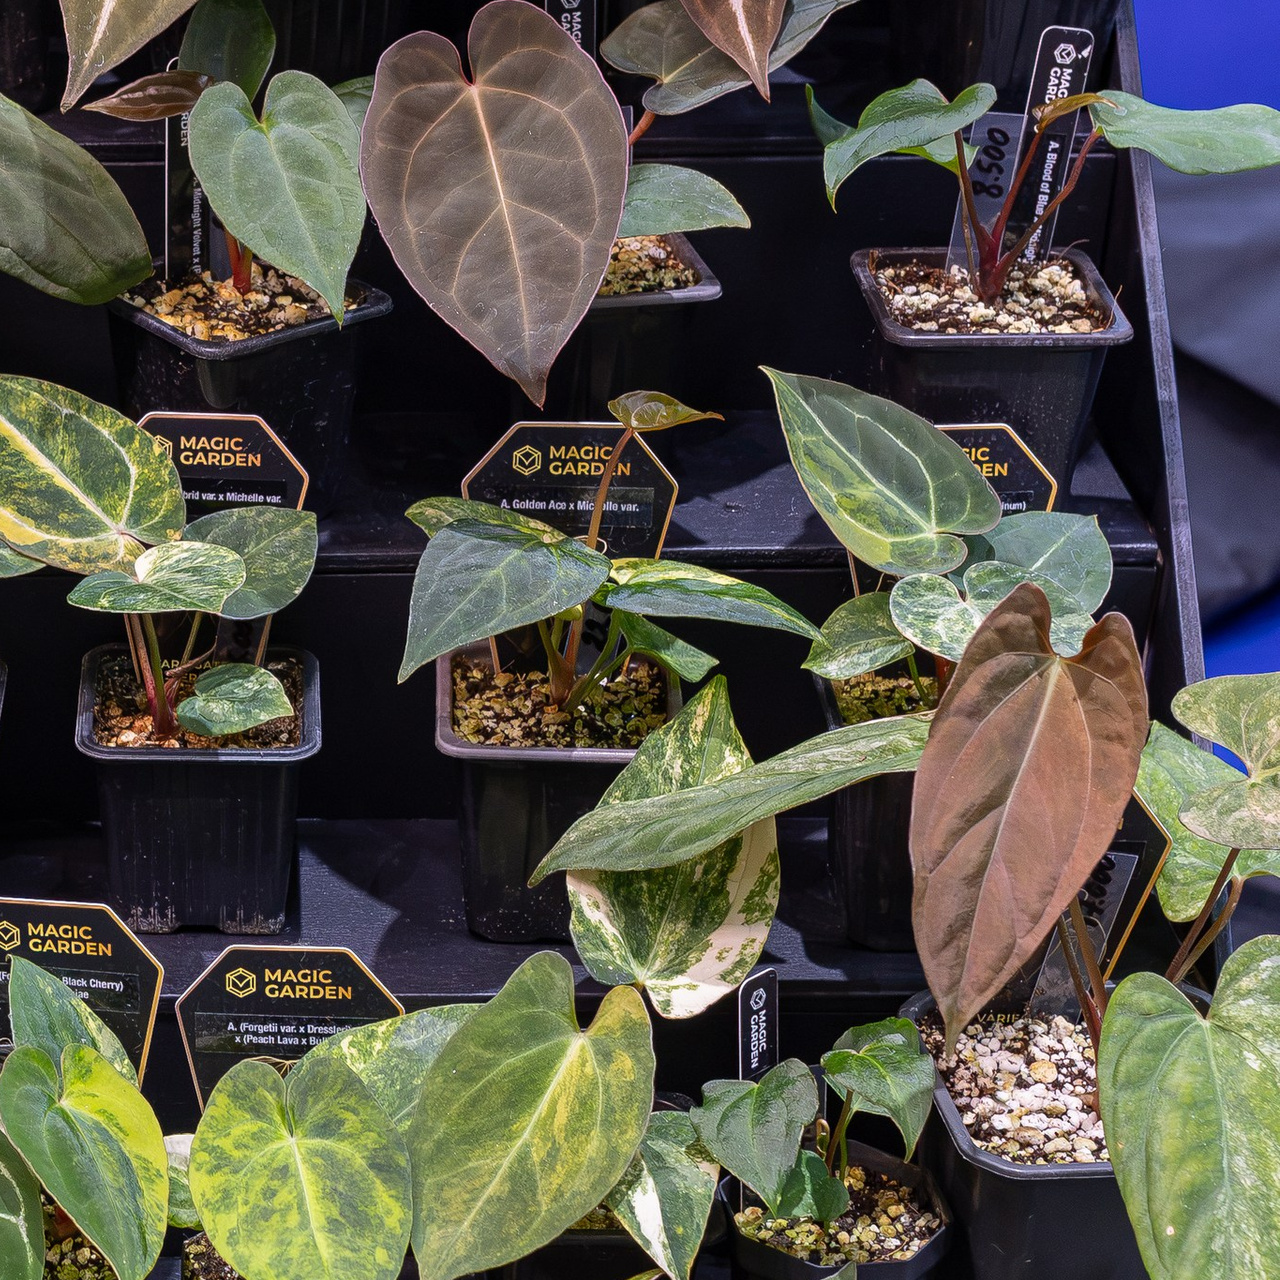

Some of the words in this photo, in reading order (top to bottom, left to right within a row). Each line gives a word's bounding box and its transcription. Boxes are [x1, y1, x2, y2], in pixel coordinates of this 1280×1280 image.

[1044, 67, 1061, 104] GARD
[1057, 68, 1073, 99] MAG
[972, 127, 1010, 199] 8.500
[1042, 153, 1057, 182] Blood
[1040, 182, 1050, 193] of
[180, 436, 243, 451] MAGIC
[180, 451, 261, 467] GARDEN
[549, 445, 613, 460] MAGIC
[549, 461, 631, 476] GARDN
[226, 493, 264, 502] Michelle
[513, 499, 546, 510] Golden
[548, 500, 566, 510] Ace
[568, 502, 575, 510] x
[621, 502, 639, 512] var.
[28, 922, 92, 940] MAGIC
[29, 938, 112, 956] GARDEN
[264, 968, 332, 983] MAGIC
[62, 976, 88, 987] Black
[90, 978, 124, 992] Cherry)
[265, 984, 352, 1000] GARDEN
[227, 1022, 237, 1031] A.
[240, 1022, 278, 1034] (Forgetii
[280, 1025, 297, 1033] var.
[758, 1010, 767, 1053] MAGIC
[243, 1034, 275, 1045] (Peach
[278, 1035, 299, 1045] Lava
[750, 1015, 759, 1069] GARDEN
